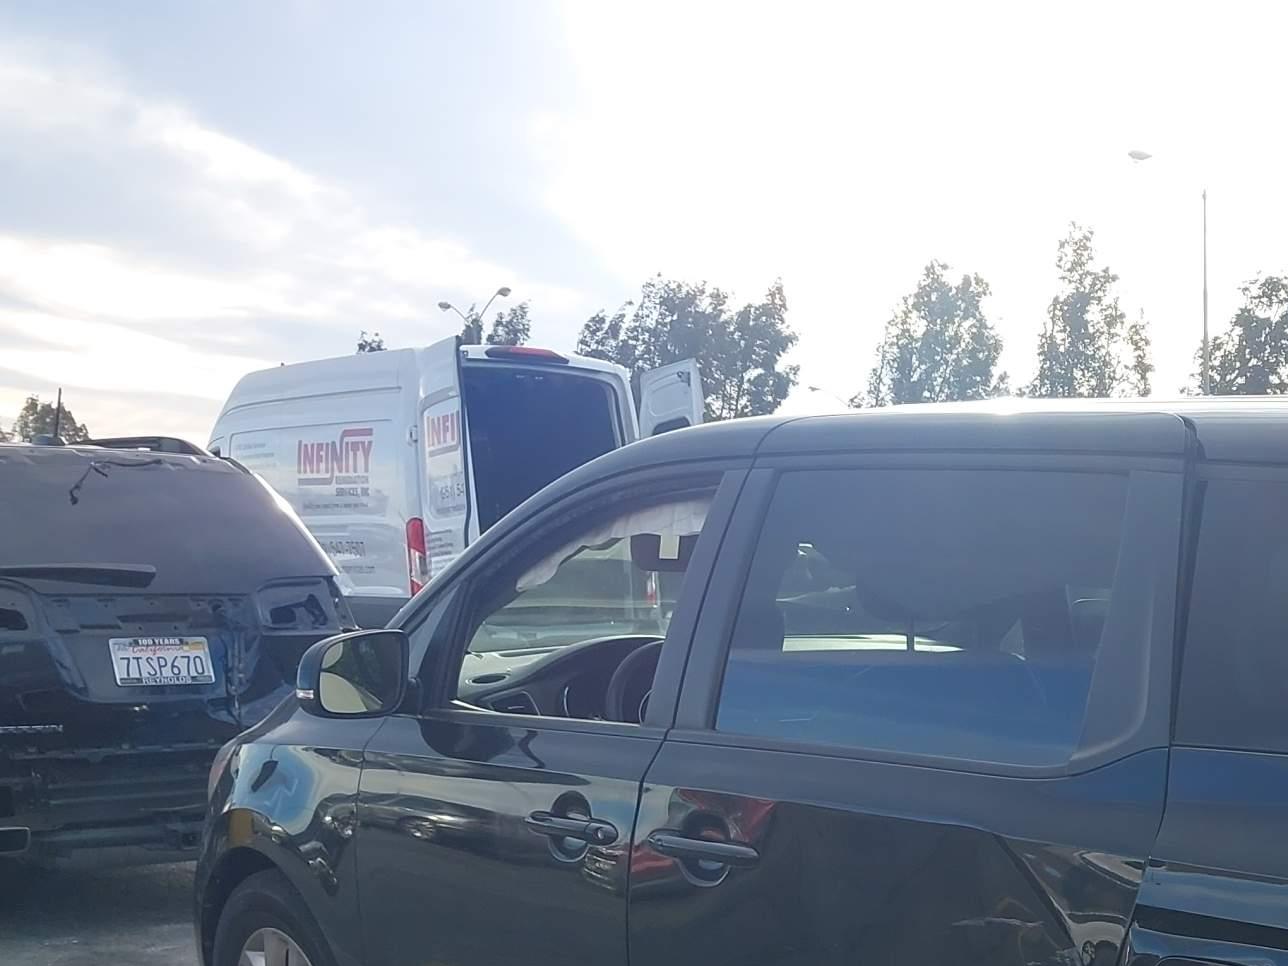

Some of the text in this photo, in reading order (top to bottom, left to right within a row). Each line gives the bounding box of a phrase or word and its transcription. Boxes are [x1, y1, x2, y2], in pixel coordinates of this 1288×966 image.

[297, 428, 373, 485] INFINITY
[155, 638, 181, 646] YEARS
[119, 655, 205, 678] 7TSP670
